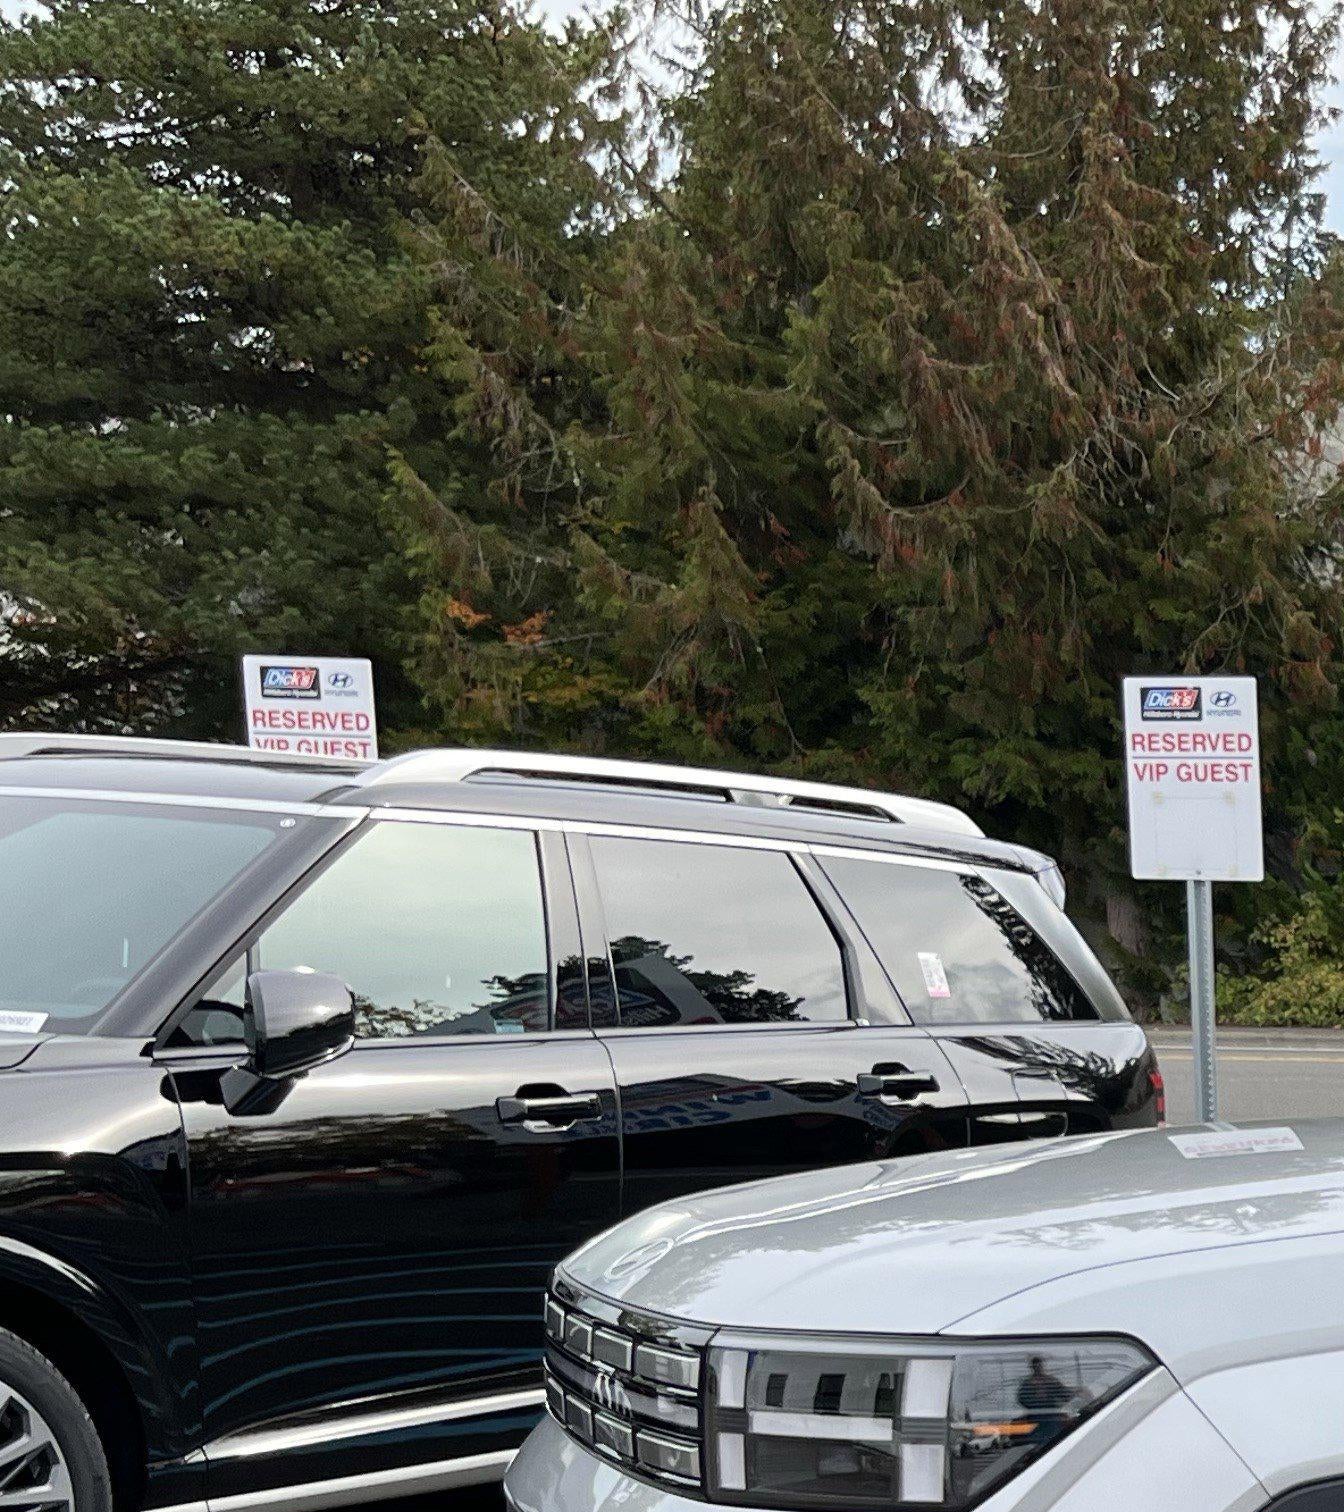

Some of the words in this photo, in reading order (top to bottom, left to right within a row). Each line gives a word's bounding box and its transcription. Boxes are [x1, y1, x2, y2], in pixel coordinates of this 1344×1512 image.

[252, 709, 370, 731] RESERVED
[1131, 733, 1252, 752] RESERVED
[1133, 763, 1168, 782] VIP
[1176, 763, 1253, 783] GUEST
